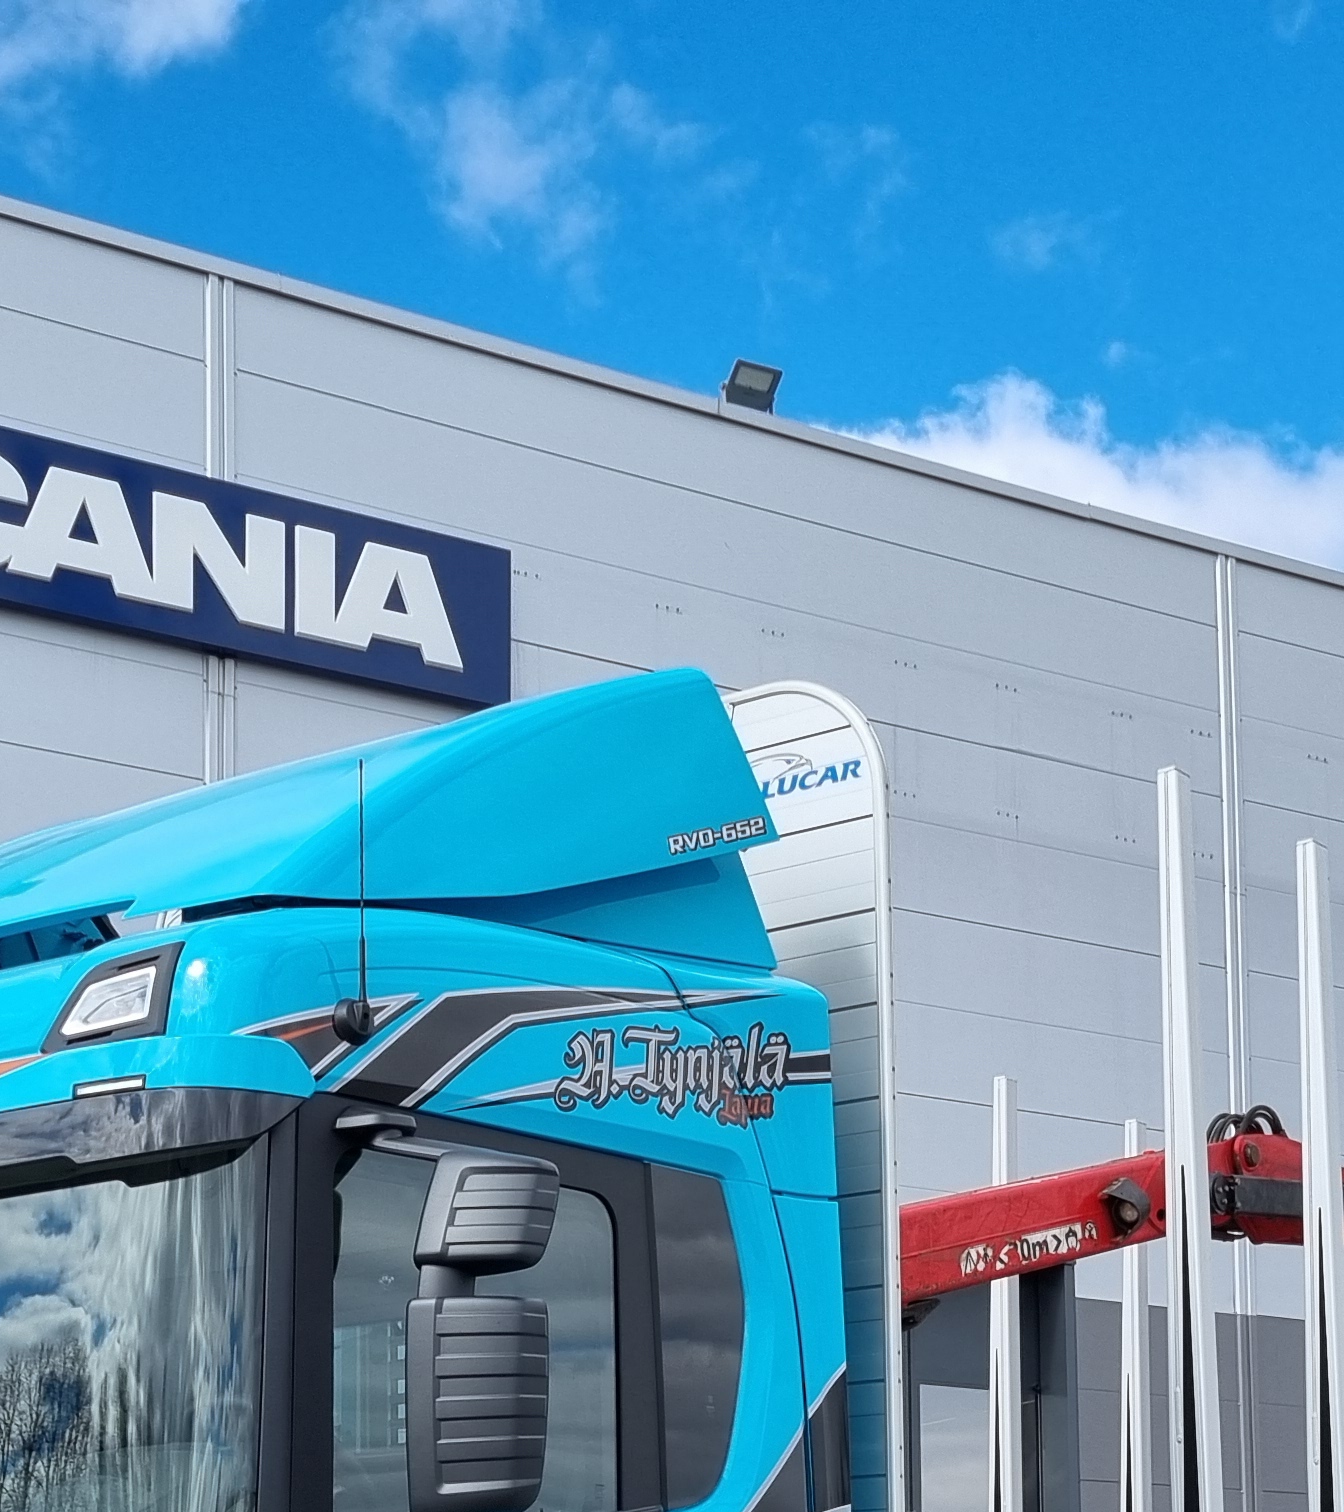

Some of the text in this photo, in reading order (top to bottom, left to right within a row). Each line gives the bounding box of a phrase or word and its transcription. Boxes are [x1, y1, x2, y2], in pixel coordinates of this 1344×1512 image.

[761, 759, 862, 799] LUCAR
[667, 815, 767, 856] RVO-652
[623, 1023, 790, 1117] Tynjälä
